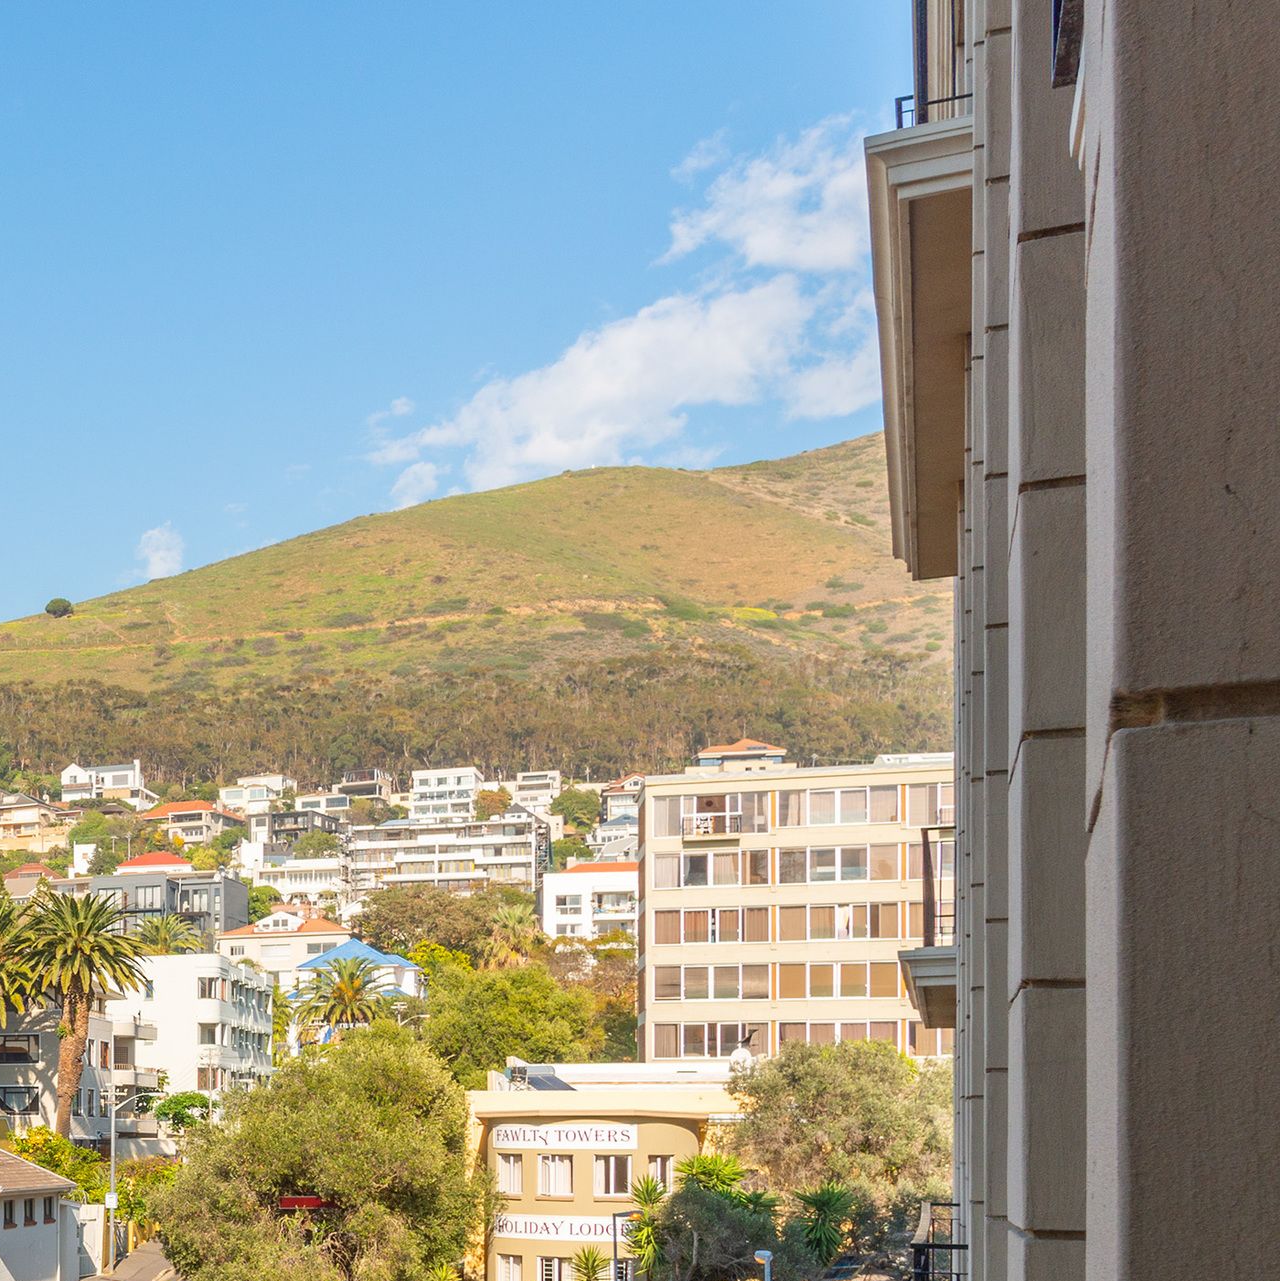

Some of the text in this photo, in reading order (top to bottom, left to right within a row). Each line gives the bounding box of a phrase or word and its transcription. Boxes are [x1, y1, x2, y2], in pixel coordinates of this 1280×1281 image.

[496, 1128, 631, 1145] FAWLTY TOWERS
[497, 1219, 564, 1235] HOLIDAY
